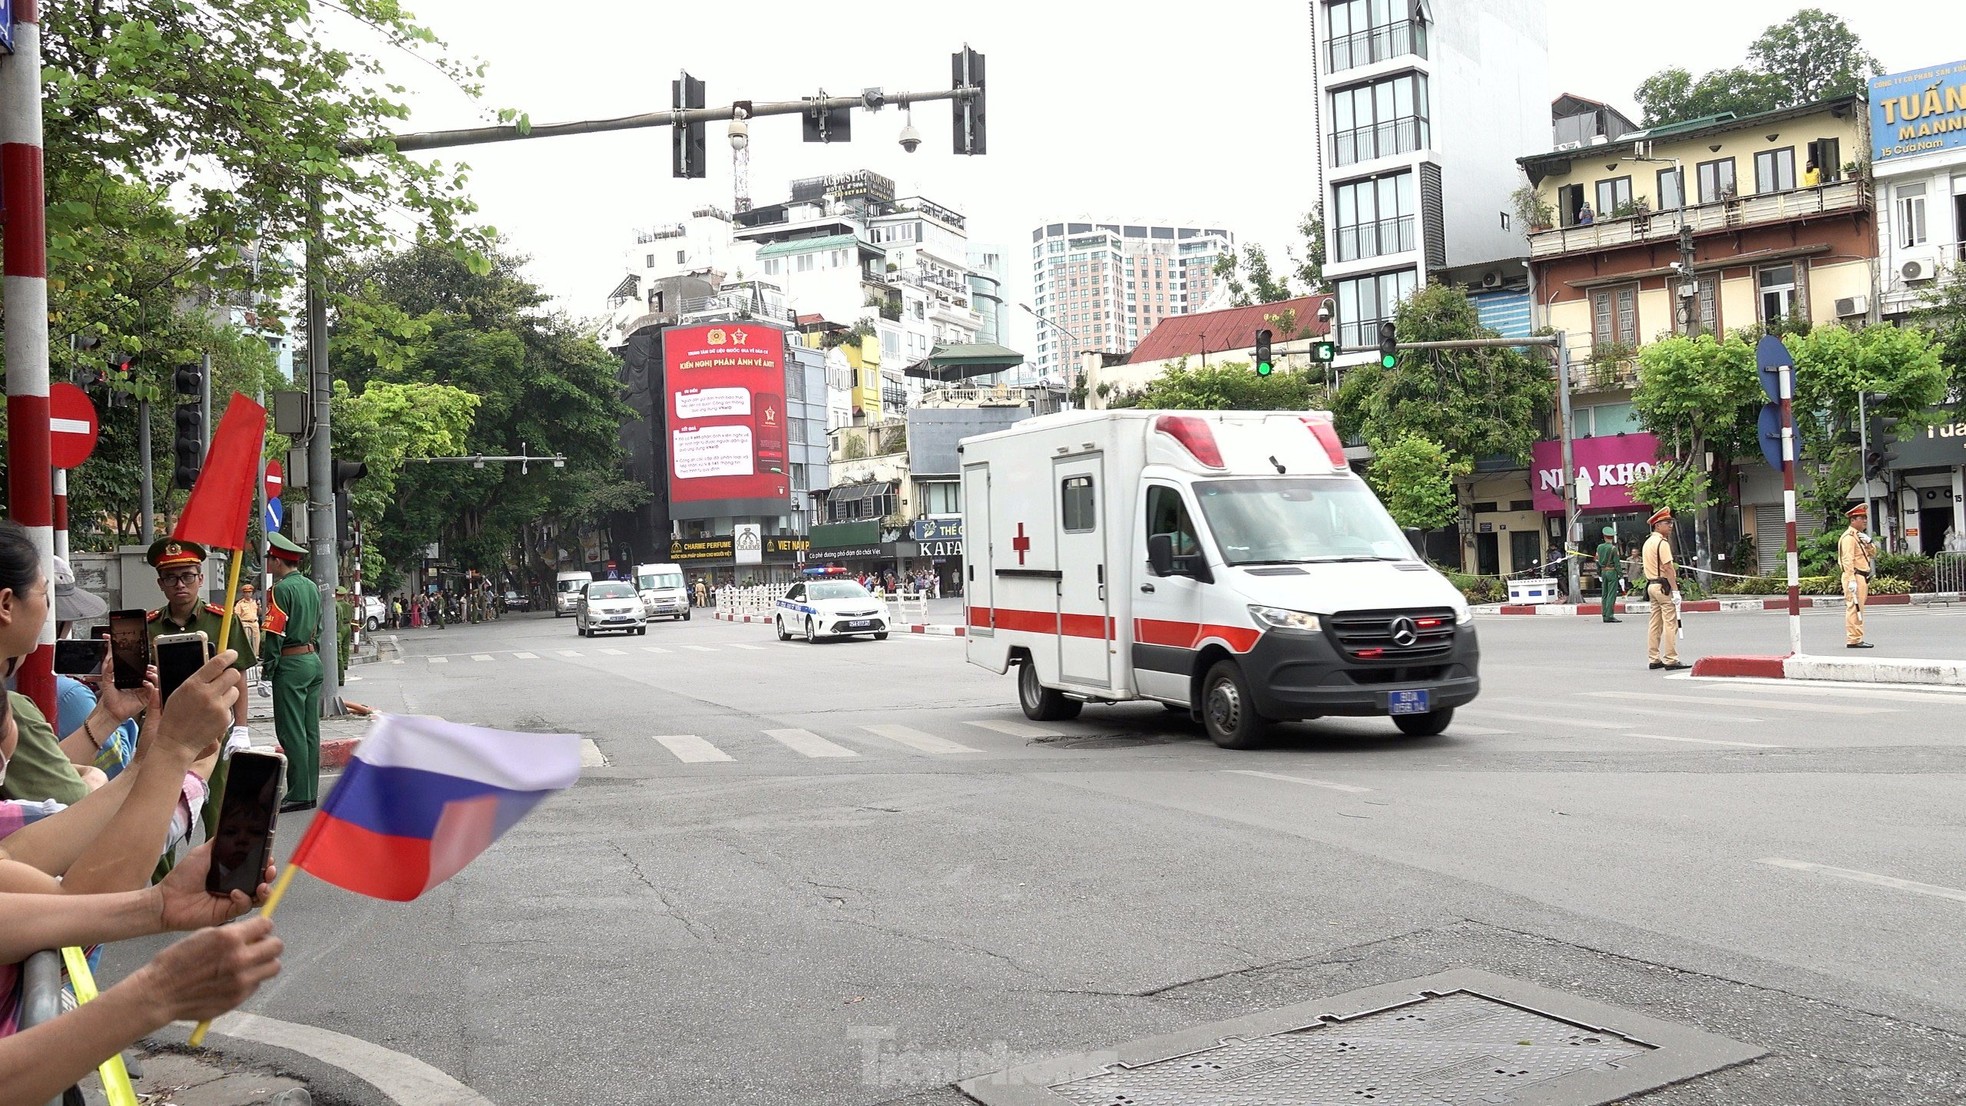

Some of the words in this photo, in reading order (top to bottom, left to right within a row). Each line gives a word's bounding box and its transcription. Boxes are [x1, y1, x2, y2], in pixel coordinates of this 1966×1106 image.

[1882, 147, 1892, 157] 15
[1918, 140, 1943, 150] Nam
[1319, 346, 1330, 359] 16
[695, 360, 712, 368] NGHỊ
[940, 523, 957, 536] THẾ
[778, 540, 791, 550] VIET
[919, 541, 963, 556] KAFA
